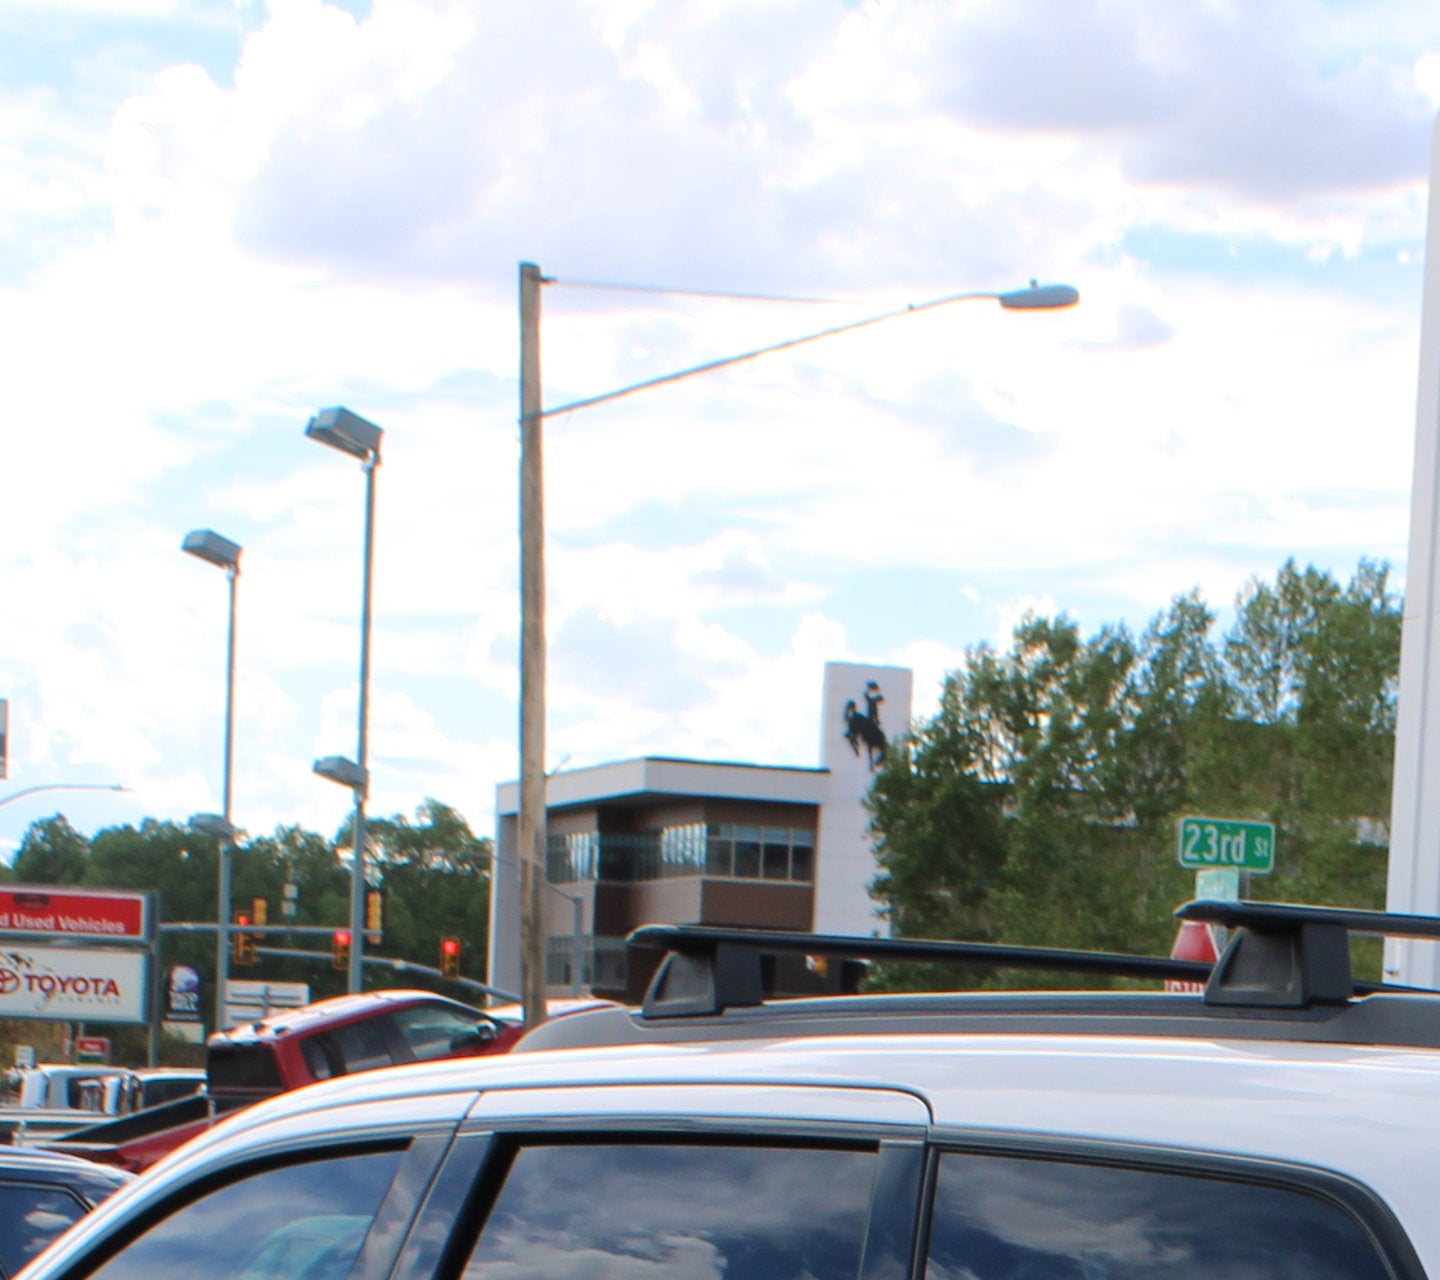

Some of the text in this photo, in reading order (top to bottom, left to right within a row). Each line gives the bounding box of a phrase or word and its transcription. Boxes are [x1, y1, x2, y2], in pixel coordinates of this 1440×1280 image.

[1183, 823, 1269, 864] 23rd St
[12, 913, 56, 930] Used
[58, 916, 126, 934] Vehicles
[24, 974, 121, 996] TOYOTA
